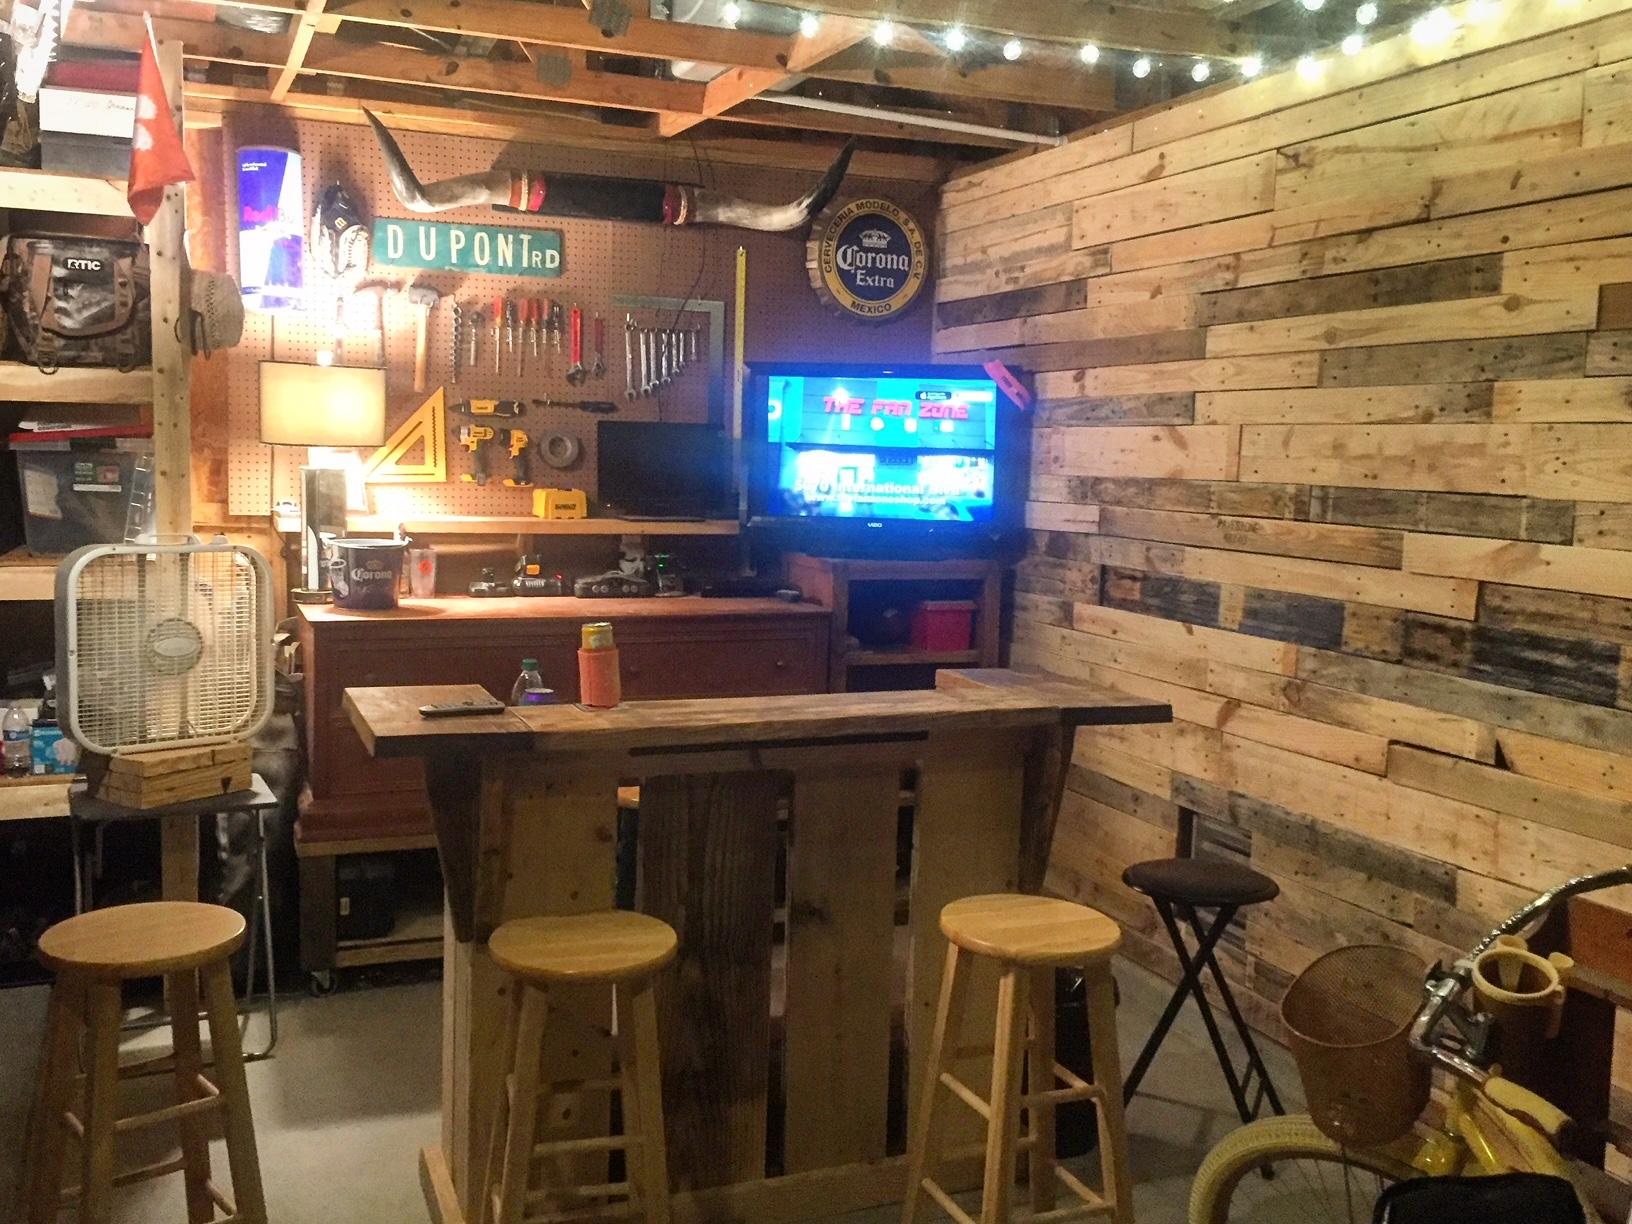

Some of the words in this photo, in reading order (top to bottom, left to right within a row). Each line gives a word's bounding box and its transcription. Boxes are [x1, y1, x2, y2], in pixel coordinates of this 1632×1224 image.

[386, 224, 532, 268] DUPONT
[532, 249, 560, 269] RD
[823, 207, 854, 273] CERVECERIA
[914, 241, 923, 257] DE
[67, 259, 101, 270] RTIC
[836, 244, 909, 273] Corona
[856, 269, 894, 288] Extra
[851, 301, 892, 314] MEXICO
[823, 396, 865, 415] THE
[919, 402, 970, 420] ZONE
[351, 568, 392, 582] Corona
